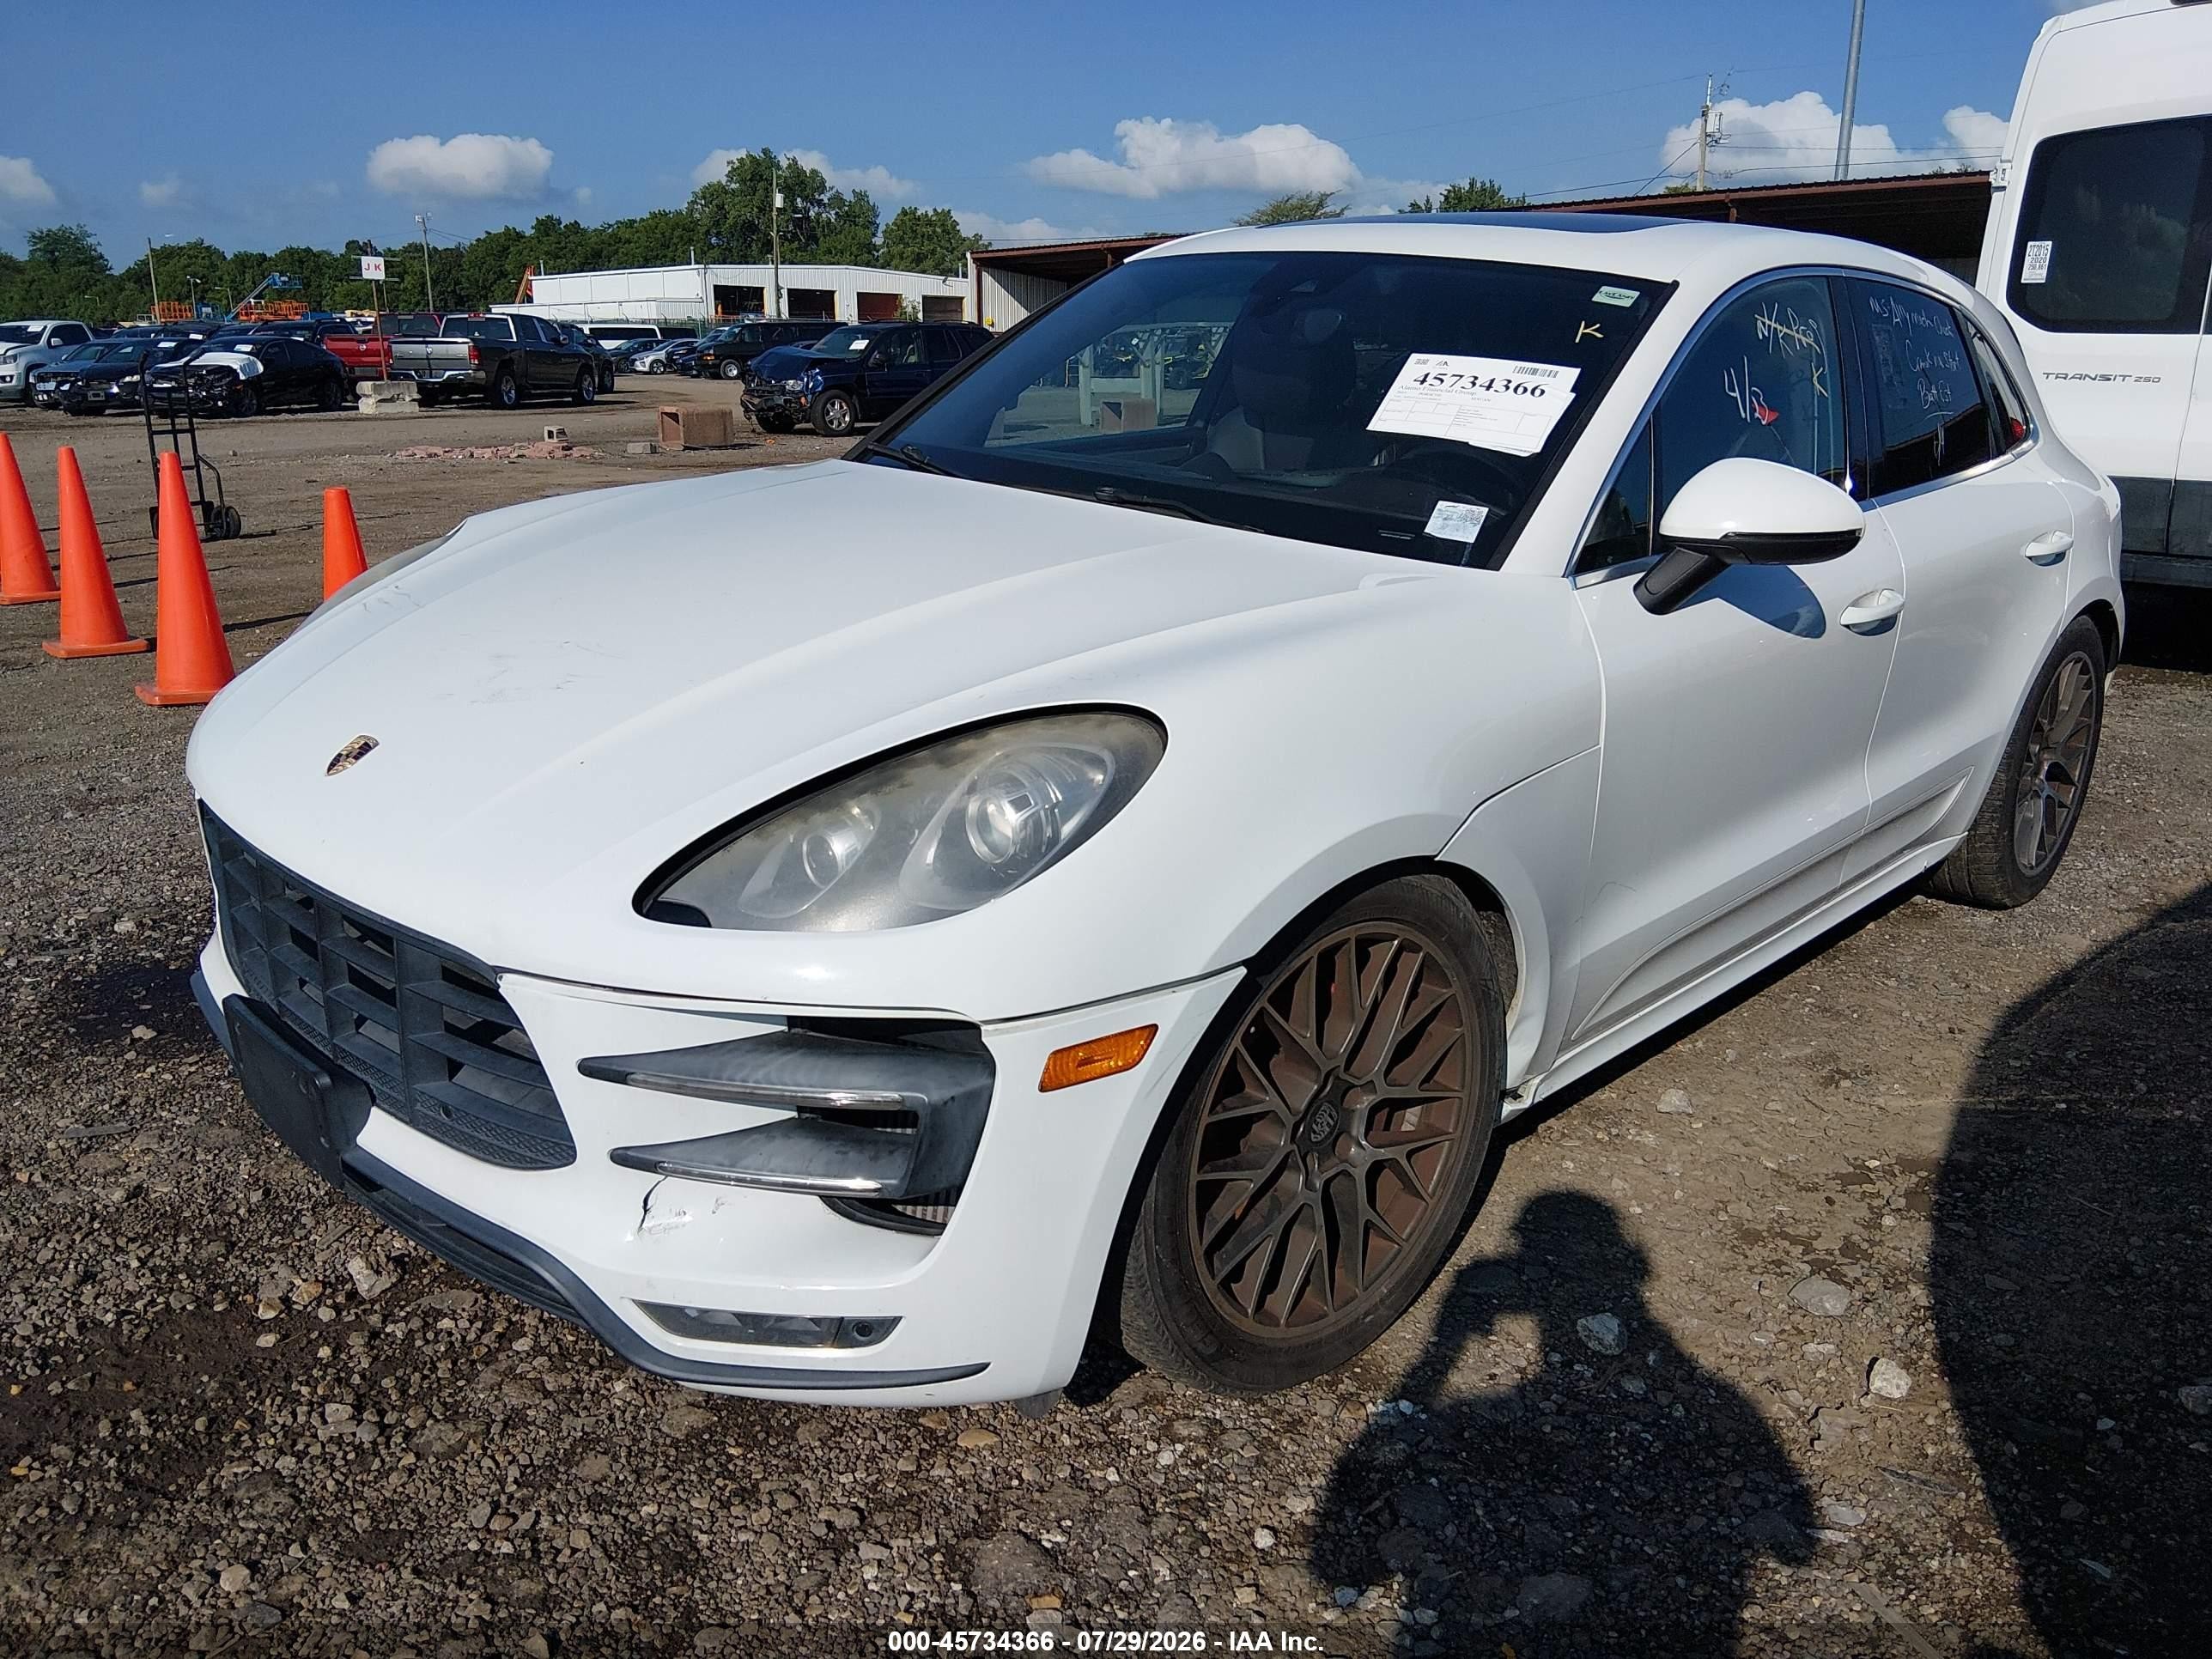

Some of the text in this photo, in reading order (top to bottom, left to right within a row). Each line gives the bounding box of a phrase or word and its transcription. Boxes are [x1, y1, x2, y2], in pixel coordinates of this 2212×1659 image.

[1575, 320, 1604, 343] K
[1413, 371, 1551, 398] 45734366
[2042, 372, 2162, 384] TRANSIT 250
